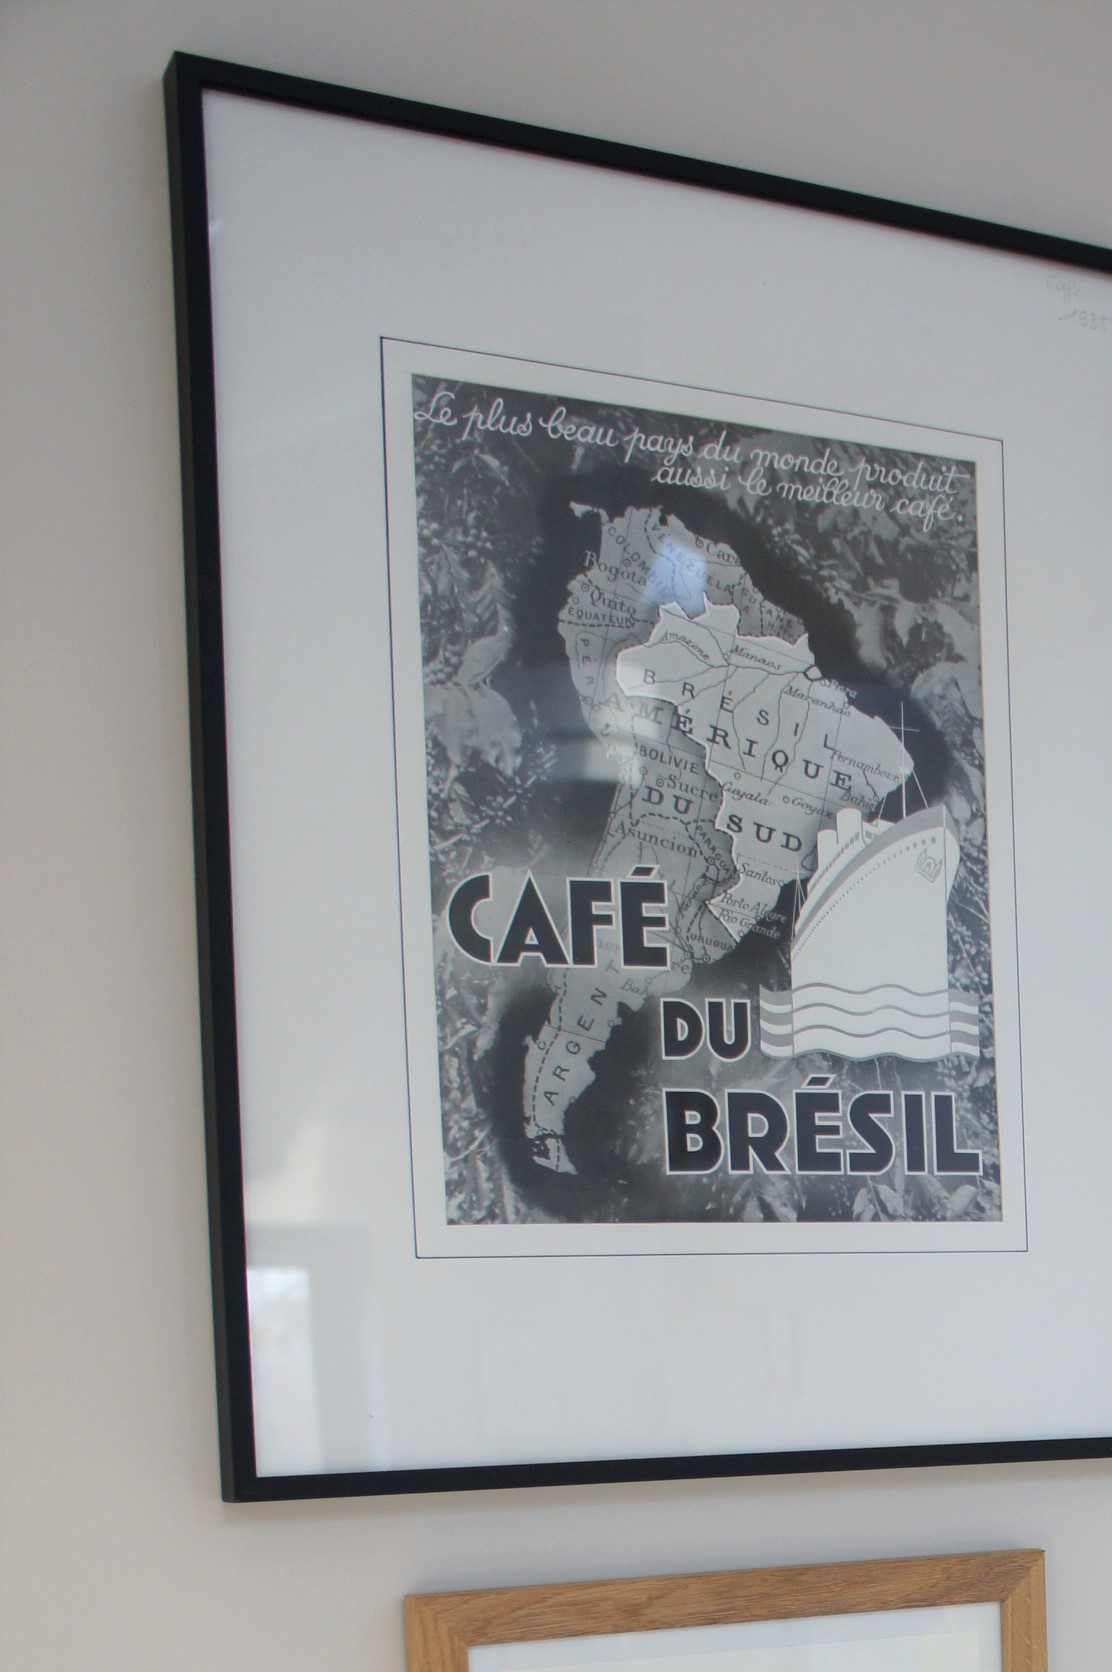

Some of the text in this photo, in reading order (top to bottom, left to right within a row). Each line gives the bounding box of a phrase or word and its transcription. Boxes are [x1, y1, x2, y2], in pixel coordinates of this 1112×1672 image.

[413, 391, 971, 494] Le plus beau pays du monde produit
[651, 465, 964, 532] aussi le meilleur café.
[590, 590, 637, 617] Quito
[638, 745, 700, 775] BOLIVIE
[666, 773, 720, 803] Sucre
[642, 785, 804, 852] DU SUD
[720, 891, 752, 911] Porto
[738, 861, 779, 887] Santos
[446, 864, 672, 969] CAFÉ
[738, 916, 781, 939] Grande
[543, 959, 621, 1106] ARGENT
[660, 998, 752, 1062] DU
[662, 1073, 984, 1176] BRÉSIL
